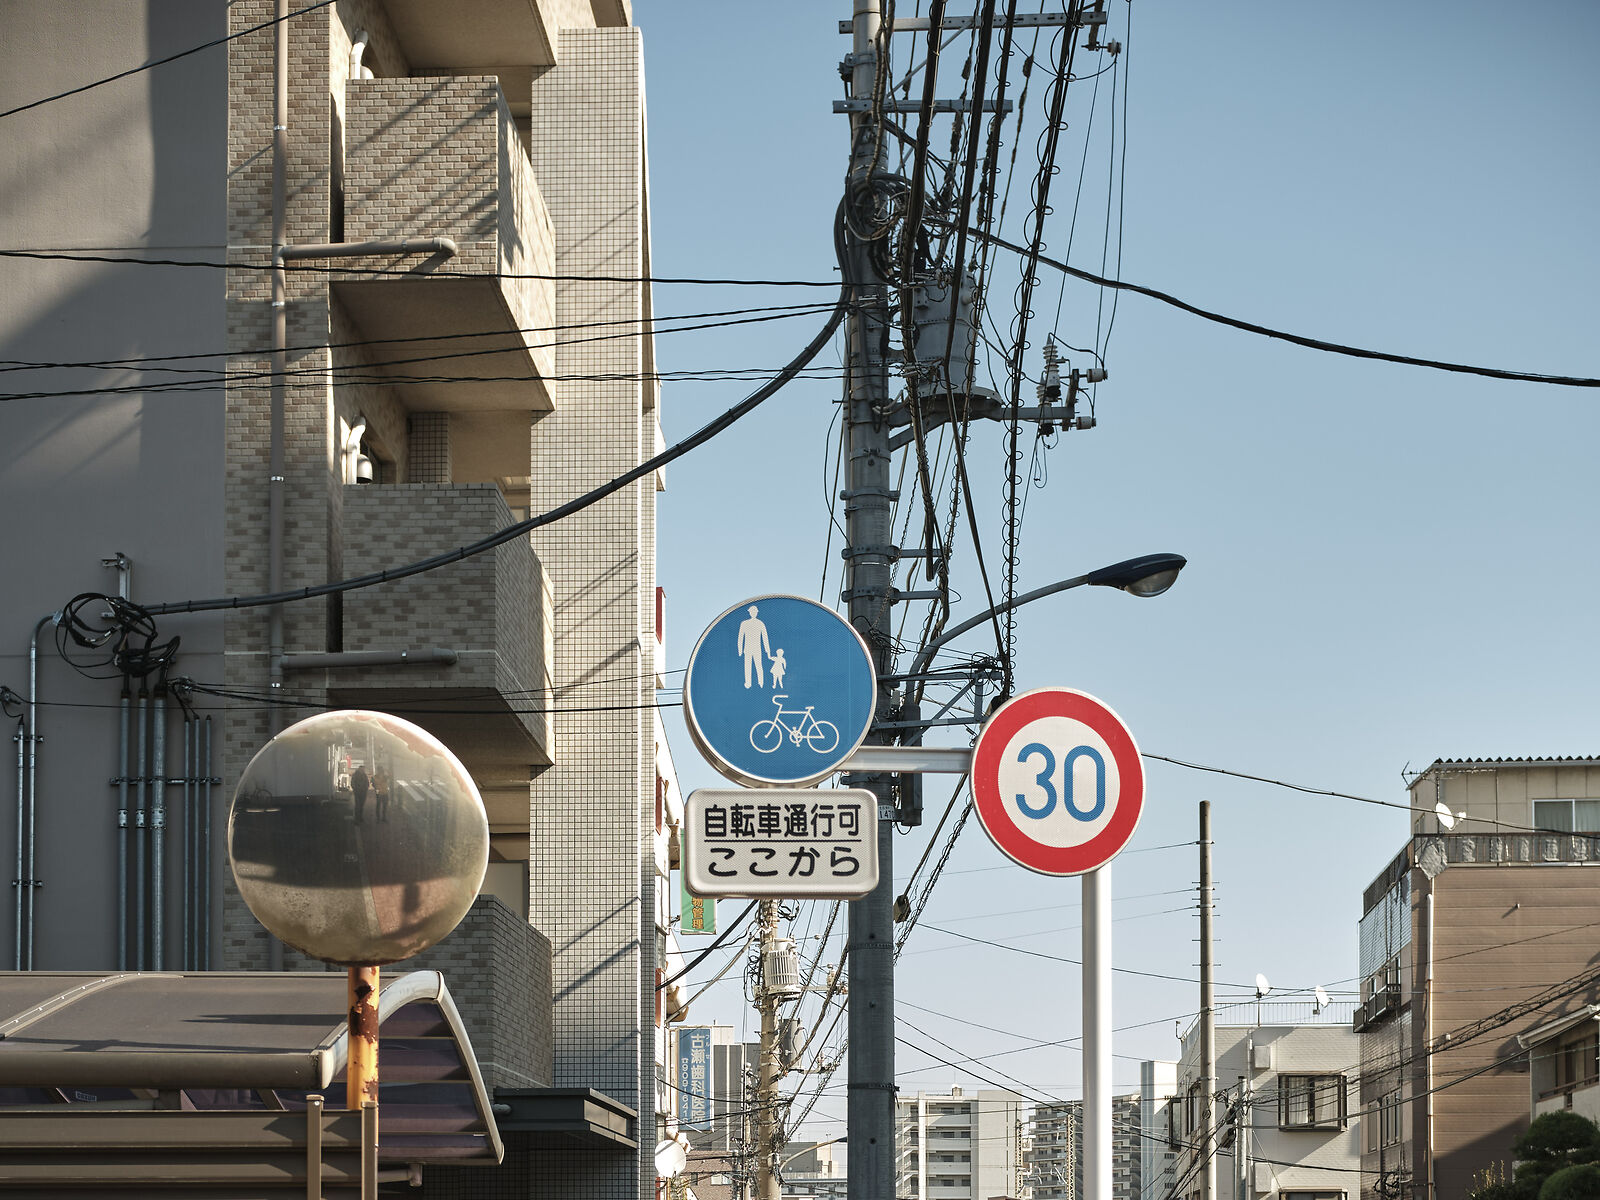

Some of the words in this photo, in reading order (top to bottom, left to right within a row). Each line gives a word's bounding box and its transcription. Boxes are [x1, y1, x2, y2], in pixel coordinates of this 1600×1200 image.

[1016, 743, 1105, 822] 30
[704, 803, 861, 838] 自転車通行可
[708, 846, 860, 877] ここから
[691, 1033, 706, 1125] 古瀬歯科医院
